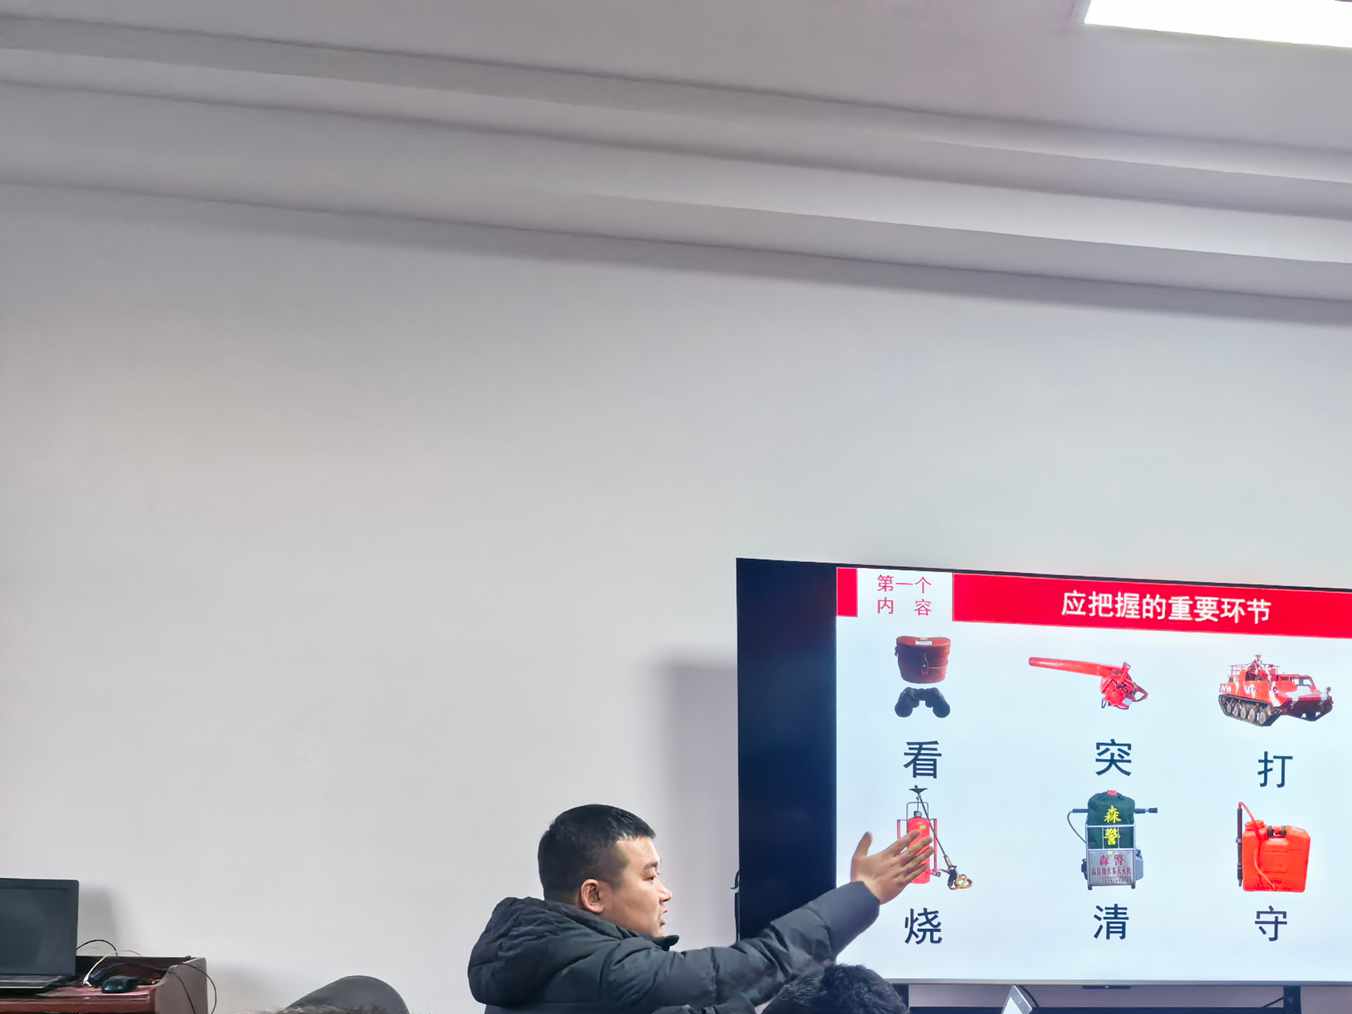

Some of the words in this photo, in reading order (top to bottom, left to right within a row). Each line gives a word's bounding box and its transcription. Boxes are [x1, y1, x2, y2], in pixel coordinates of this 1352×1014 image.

[877, 574, 932, 594] 第一个
[877, 597, 932, 616] 内容
[1060, 590, 1272, 625] 应把握的重要环节
[903, 740, 942, 779] 看
[1095, 738, 1132, 777] 突
[1257, 751, 1294, 789] 打
[904, 907, 943, 945] 烧
[1093, 903, 1129, 940] 清
[1254, 905, 1288, 942] 守
